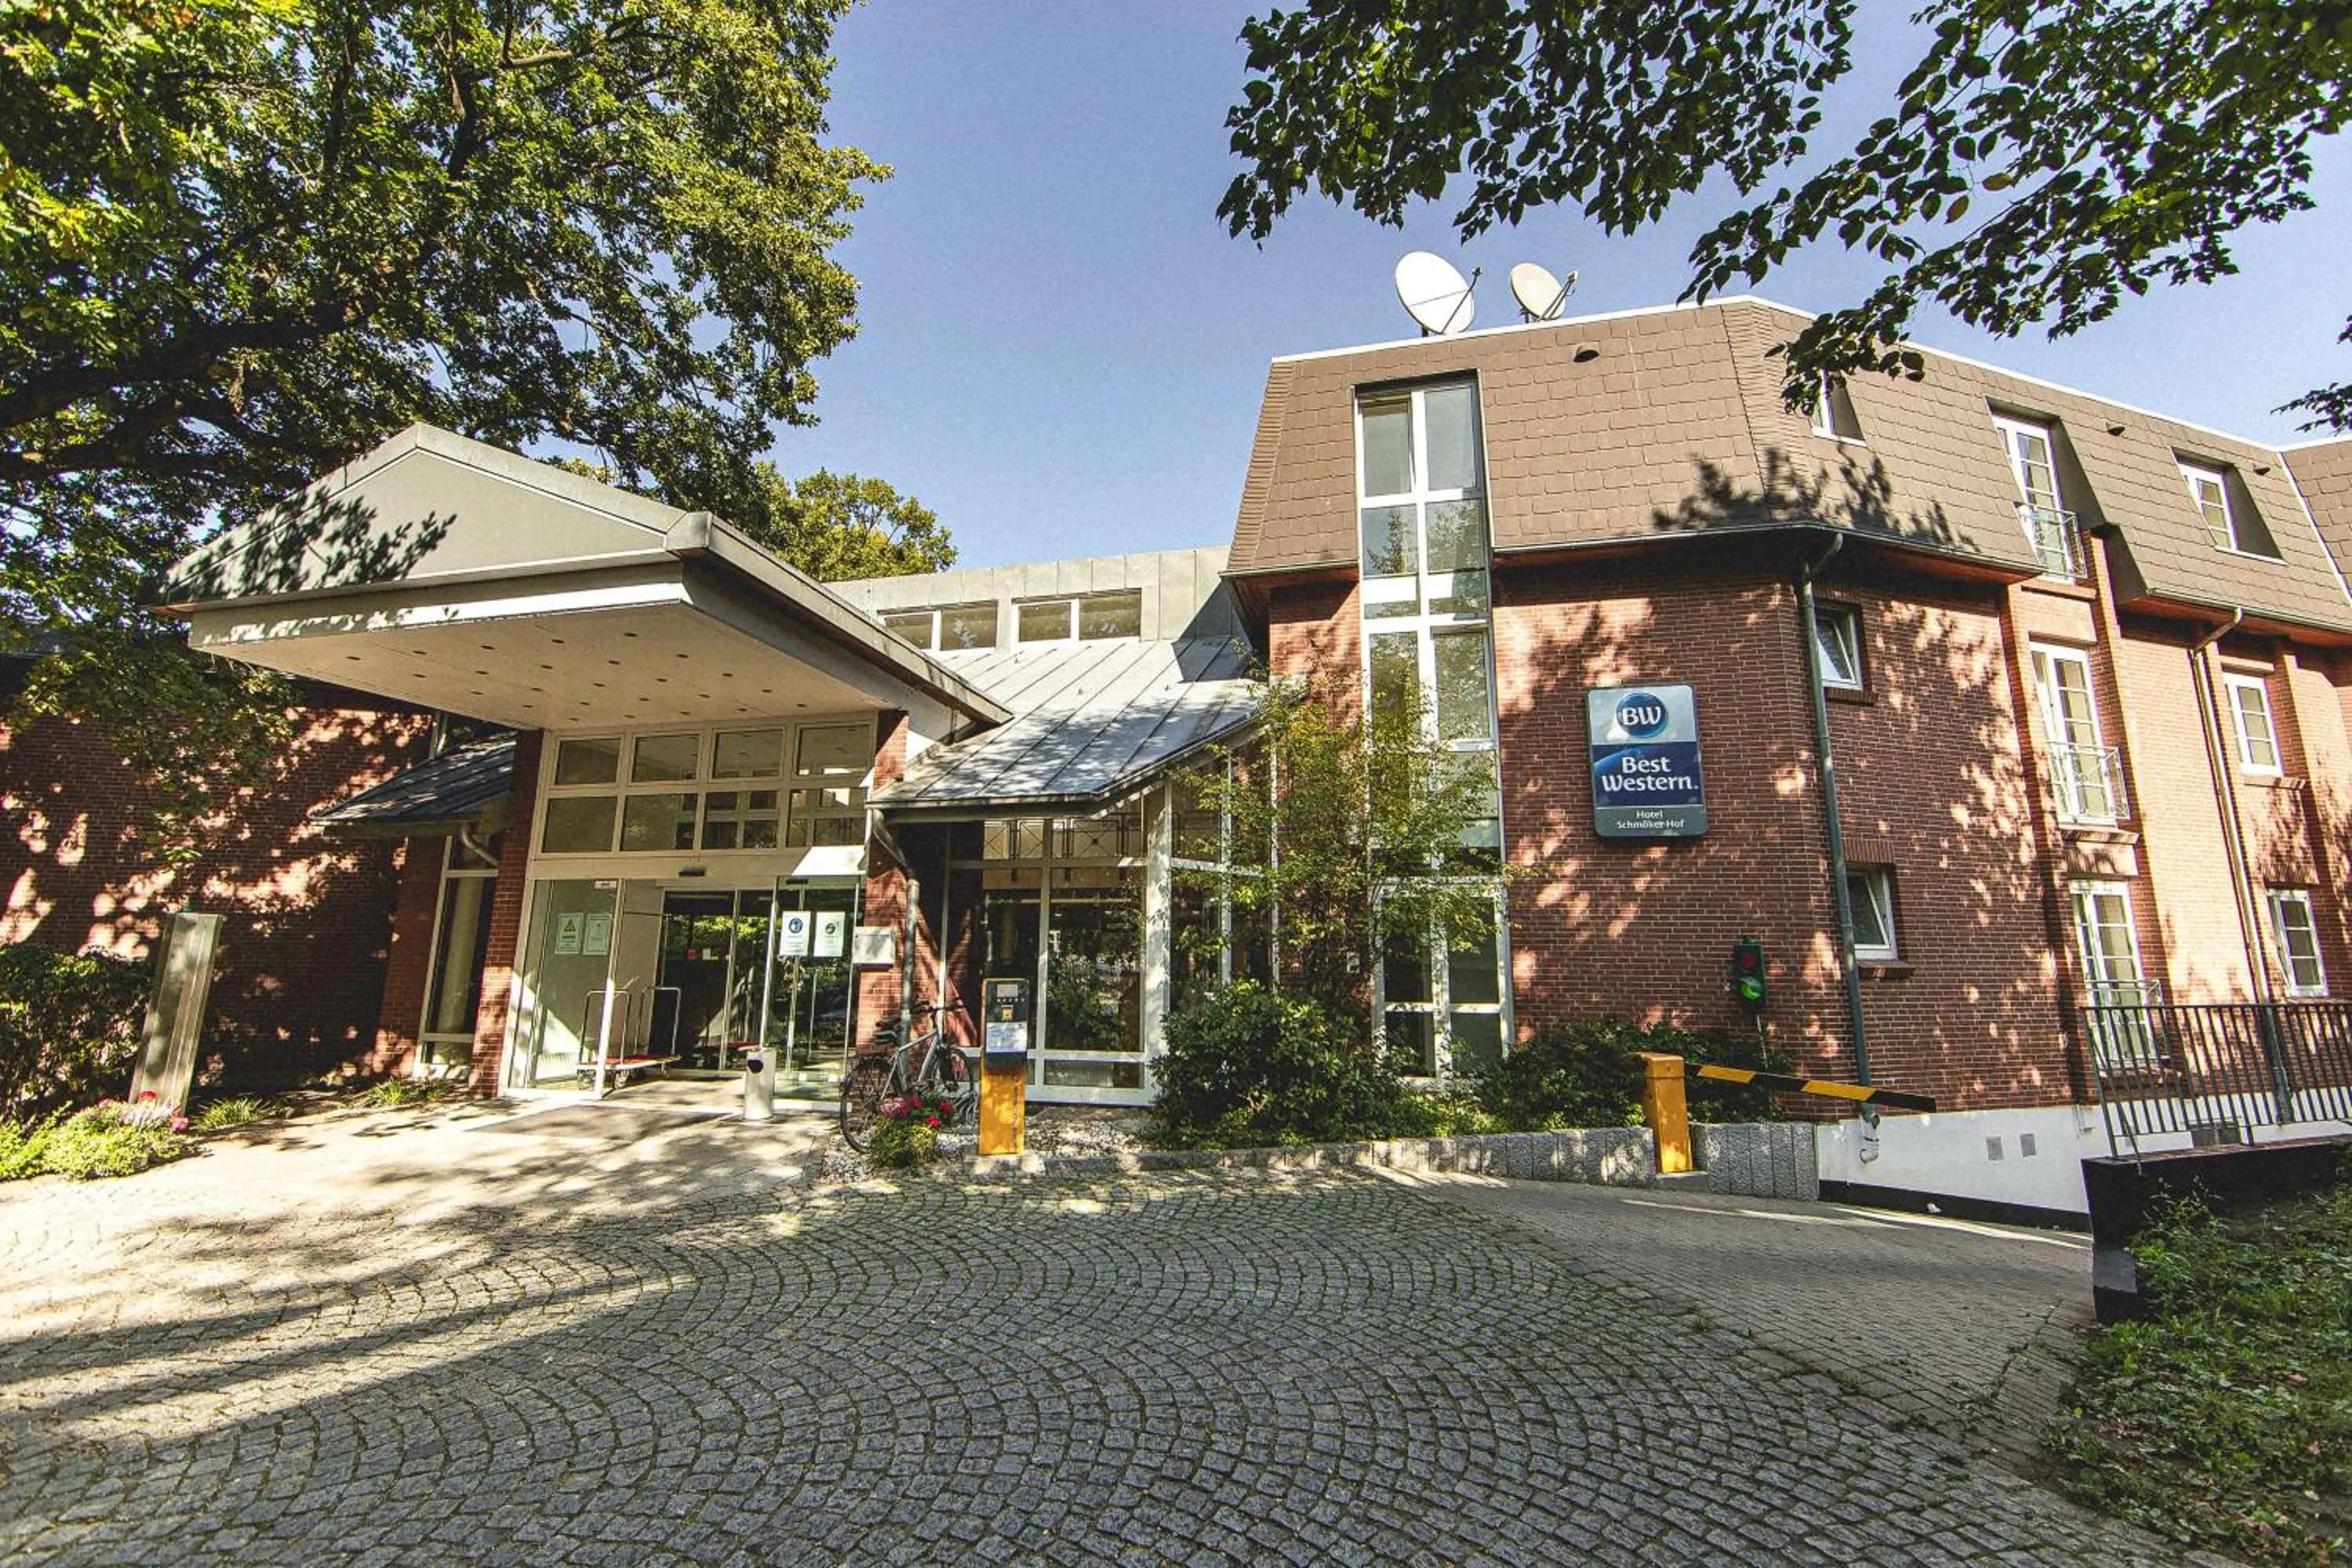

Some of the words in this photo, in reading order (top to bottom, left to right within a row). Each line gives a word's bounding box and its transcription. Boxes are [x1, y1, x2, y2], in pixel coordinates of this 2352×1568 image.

[1622, 706, 1662, 725] BW
[1621, 757, 1671, 773] Best
[1636, 810, 1663, 819] Hotel
